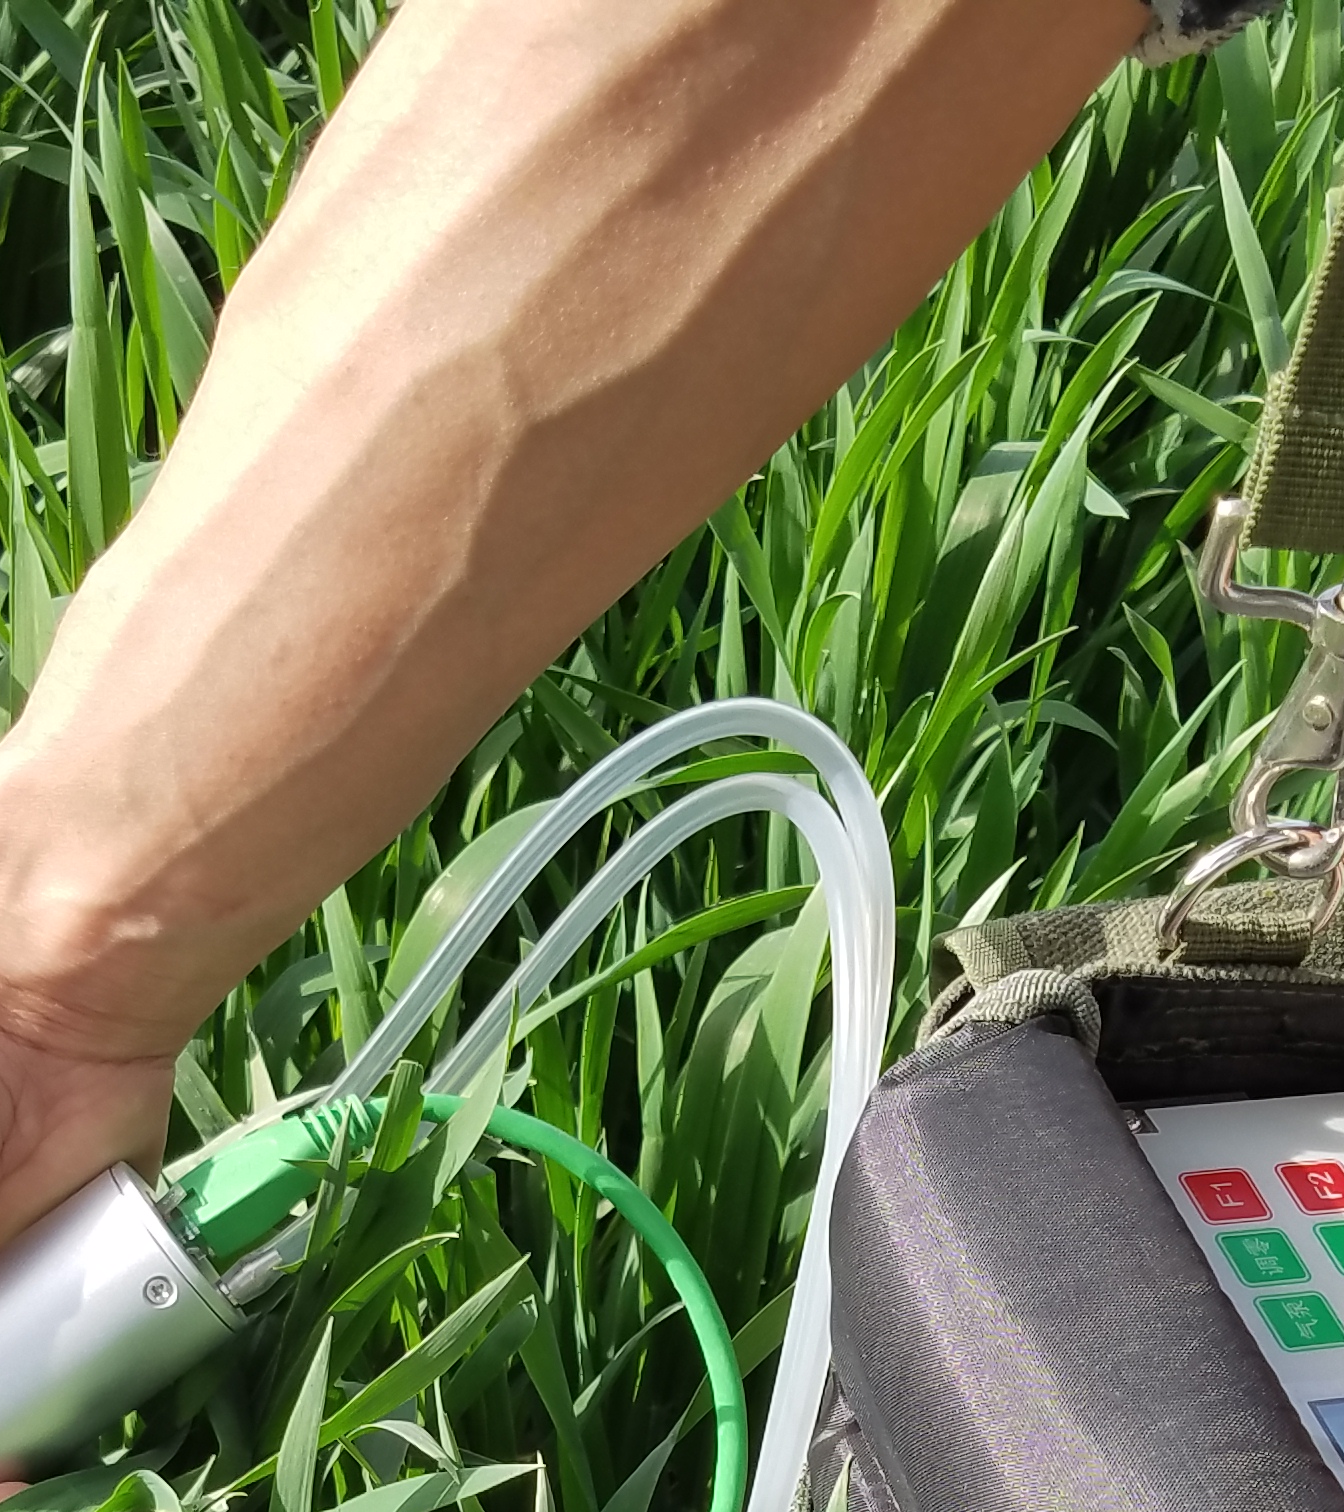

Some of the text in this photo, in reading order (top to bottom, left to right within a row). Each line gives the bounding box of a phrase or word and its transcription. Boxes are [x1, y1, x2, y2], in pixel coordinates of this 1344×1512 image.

[1220, 1181, 1244, 1208] F1
[1307, 1170, 1343, 1200] F2
[1240, 1237, 1286, 1277] 调零
[1281, 1300, 1318, 1340] 气泵
